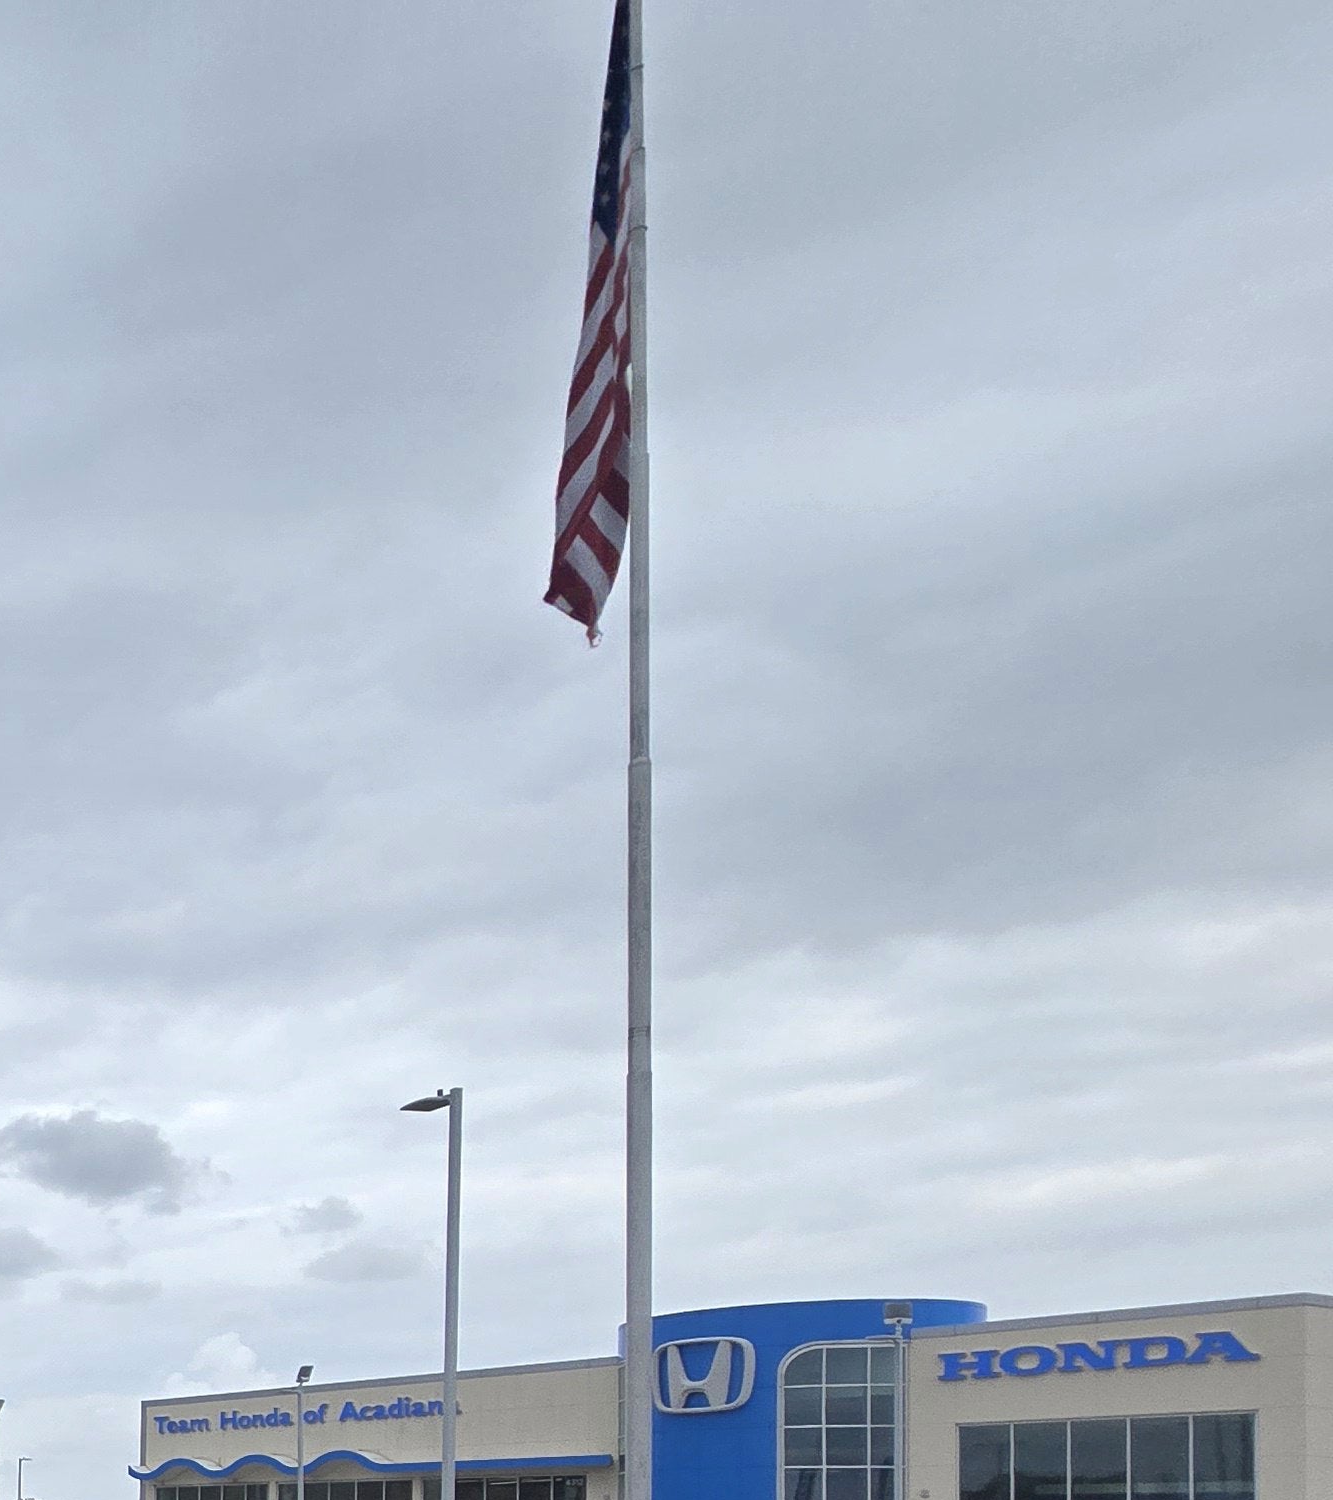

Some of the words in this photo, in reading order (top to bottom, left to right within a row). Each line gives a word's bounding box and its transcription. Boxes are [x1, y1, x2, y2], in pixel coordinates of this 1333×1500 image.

[937, 1330, 1261, 1382] HONDA
[154, 1415, 211, 1434] Team
[220, 1407, 294, 1430] Honda
[304, 1403, 329, 1424] of
[339, 1397, 462, 1422] Acadian
